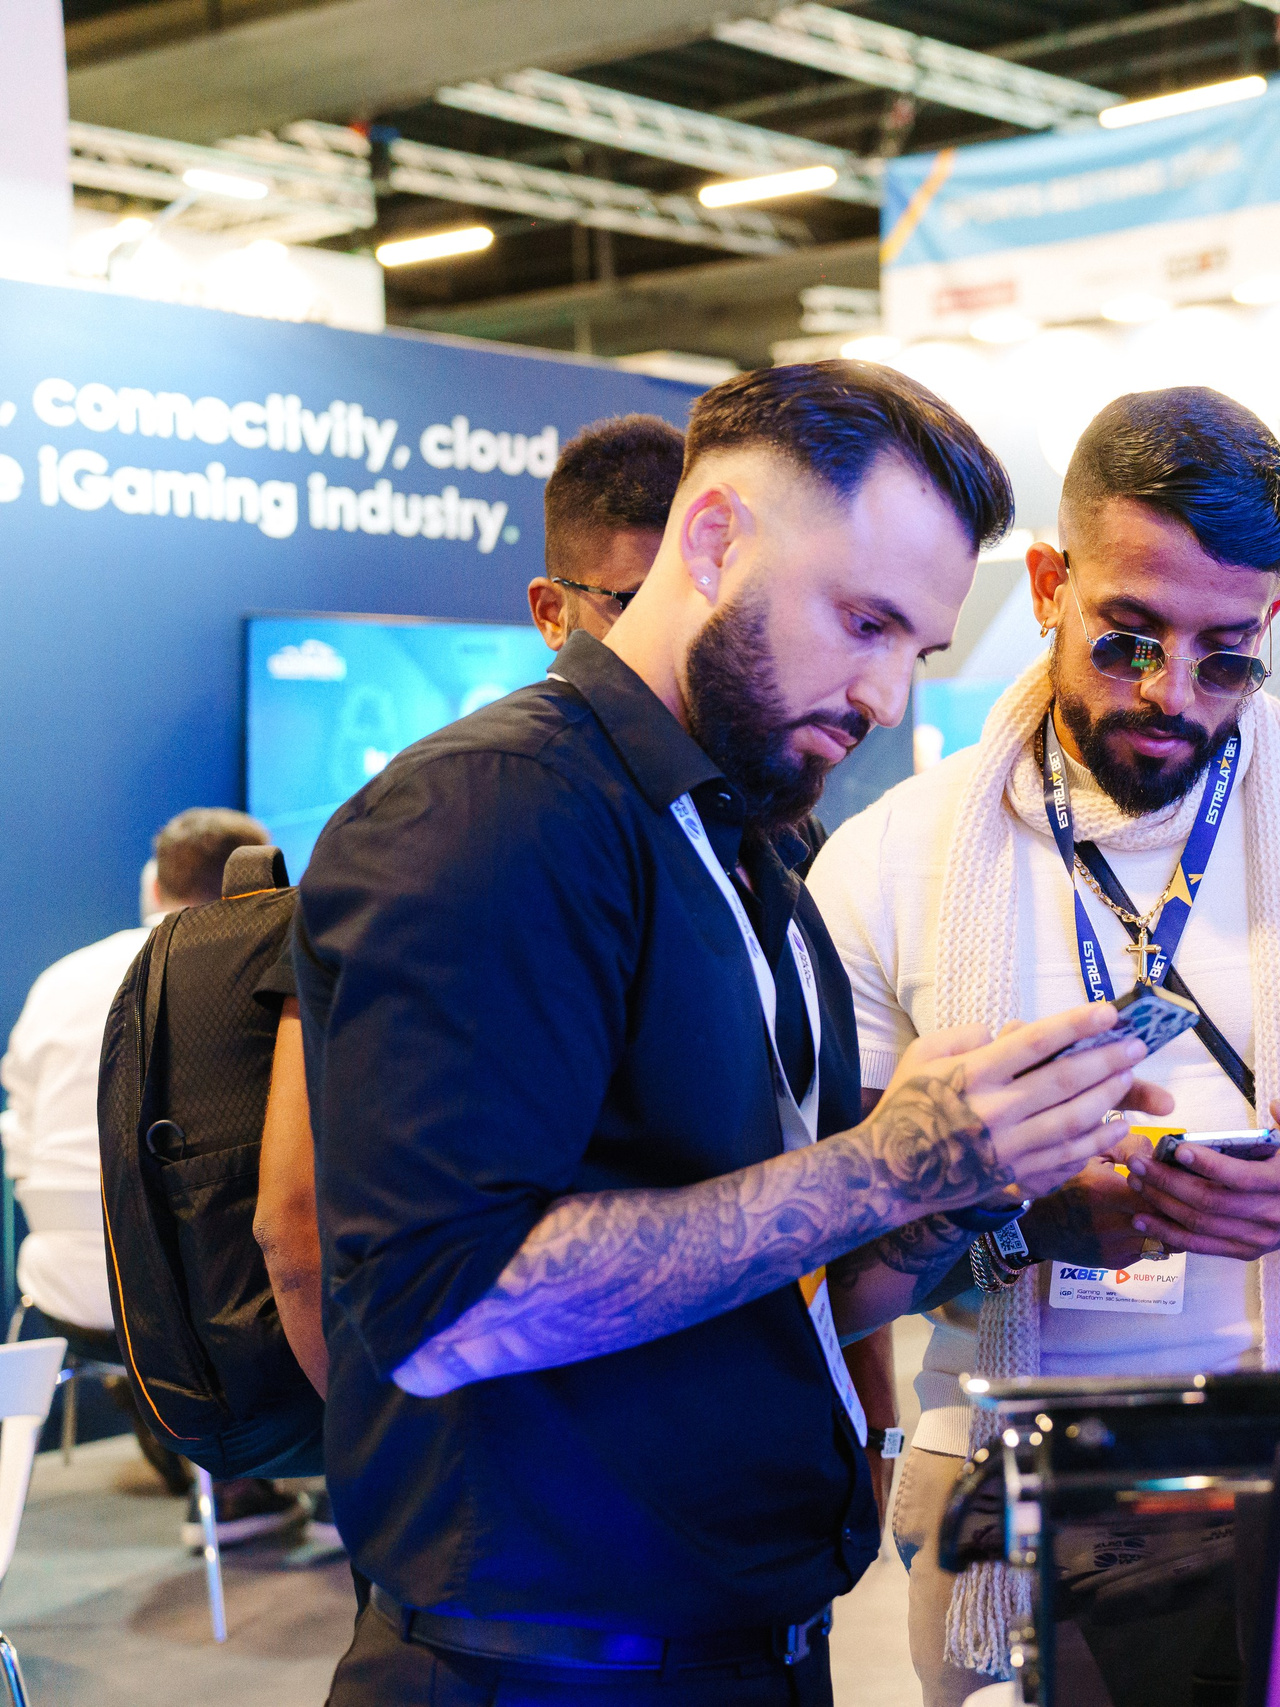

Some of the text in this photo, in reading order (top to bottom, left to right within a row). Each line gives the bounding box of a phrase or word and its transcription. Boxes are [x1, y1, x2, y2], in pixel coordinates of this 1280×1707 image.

[32, 377, 558, 480] connectivity, cloud
[38, 444, 298, 539] iGaming
[307, 472, 519, 553] industry.
[1083, 940, 1105, 1000] ESTRELA
[1060, 1267, 1109, 1282] 1XBET
[1133, 1273, 1155, 1282] RUBY
